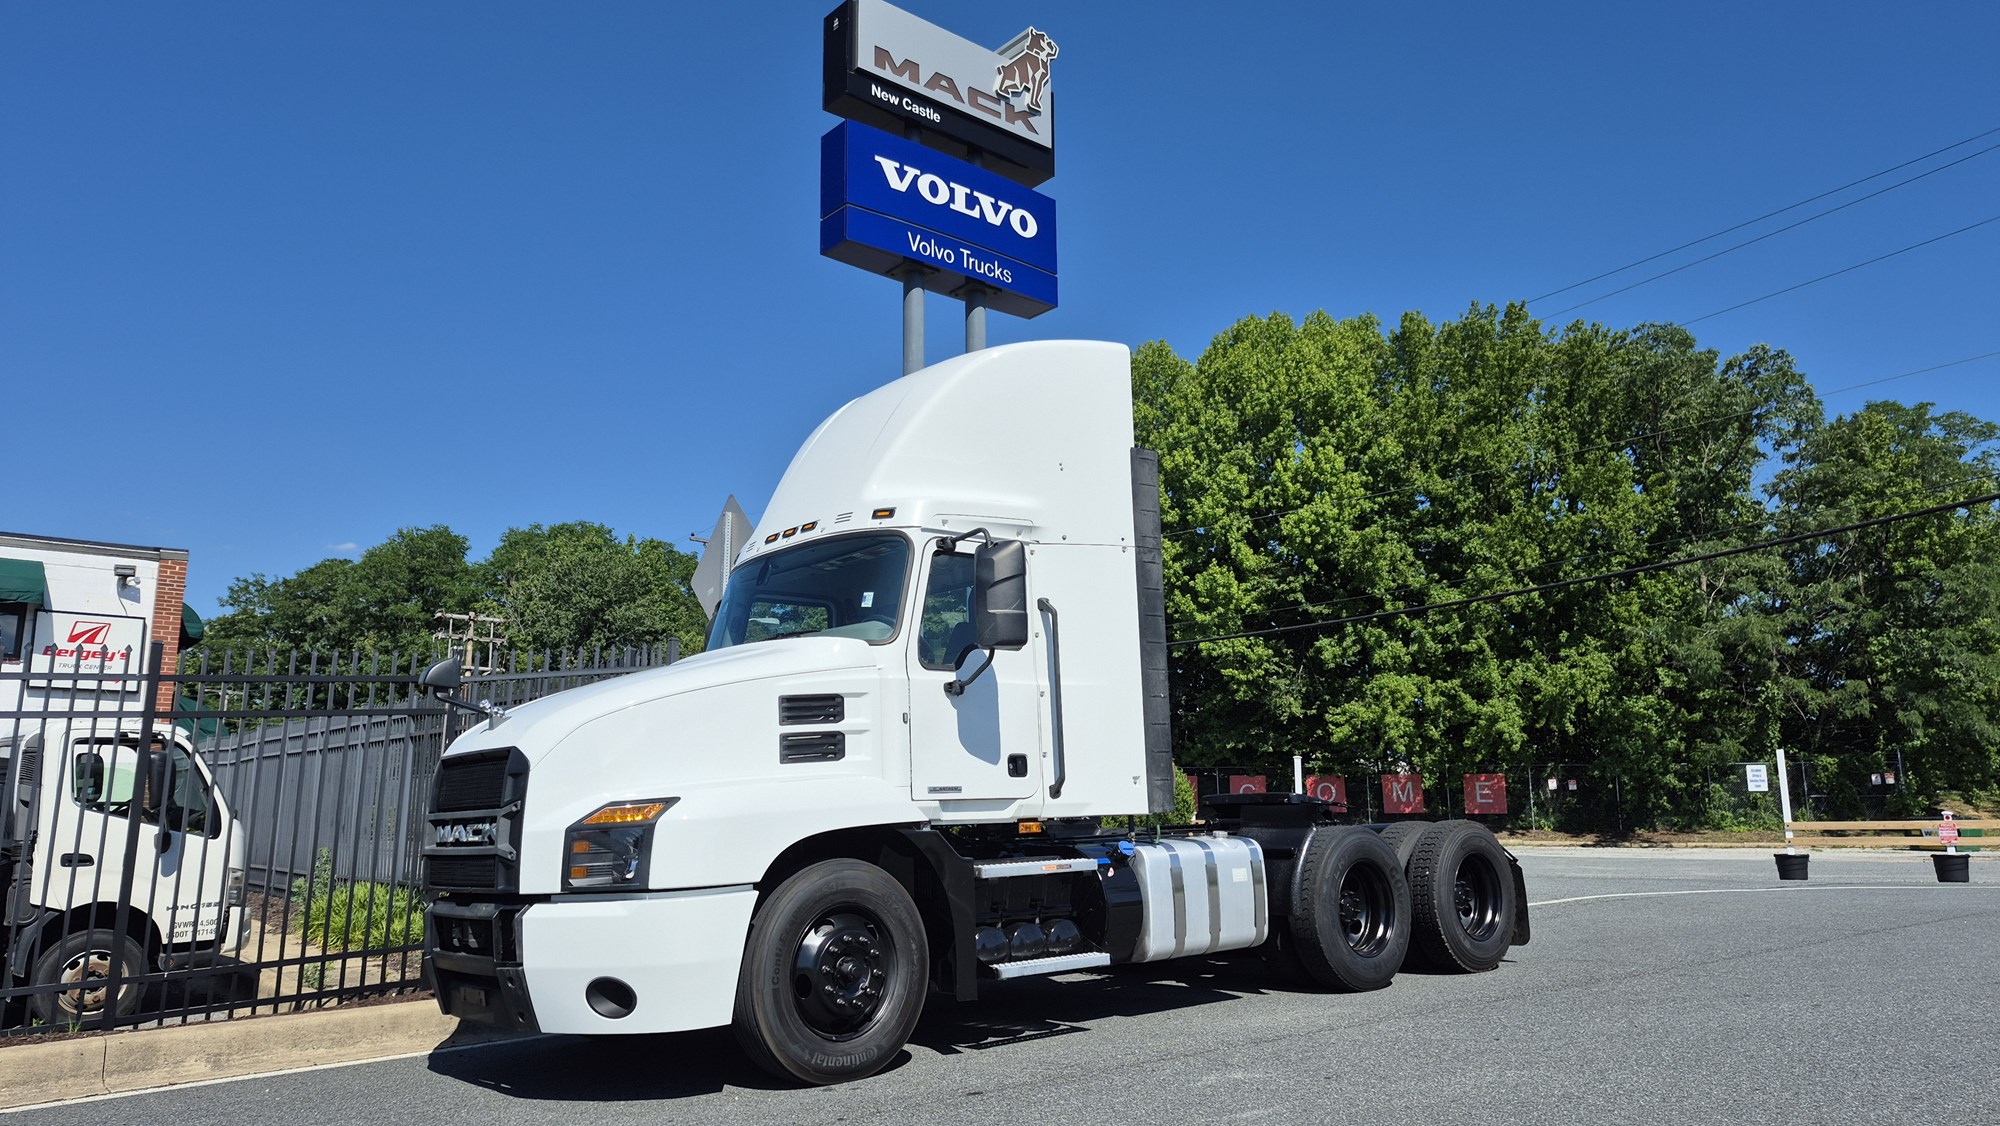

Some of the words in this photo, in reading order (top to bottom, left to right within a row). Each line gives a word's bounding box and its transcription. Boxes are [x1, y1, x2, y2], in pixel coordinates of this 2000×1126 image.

[871, 84, 900, 106] New
[902, 97, 941, 123] Castle
[874, 45, 1039, 135] MACK
[874, 154, 1038, 239] VOLVO
[907, 231, 955, 264] Volvo
[959, 247, 1012, 283] Trucks
[42, 645, 129, 662] Bergey's
[84, 663, 113, 671] CENER
[436, 823, 497, 843] MACK
